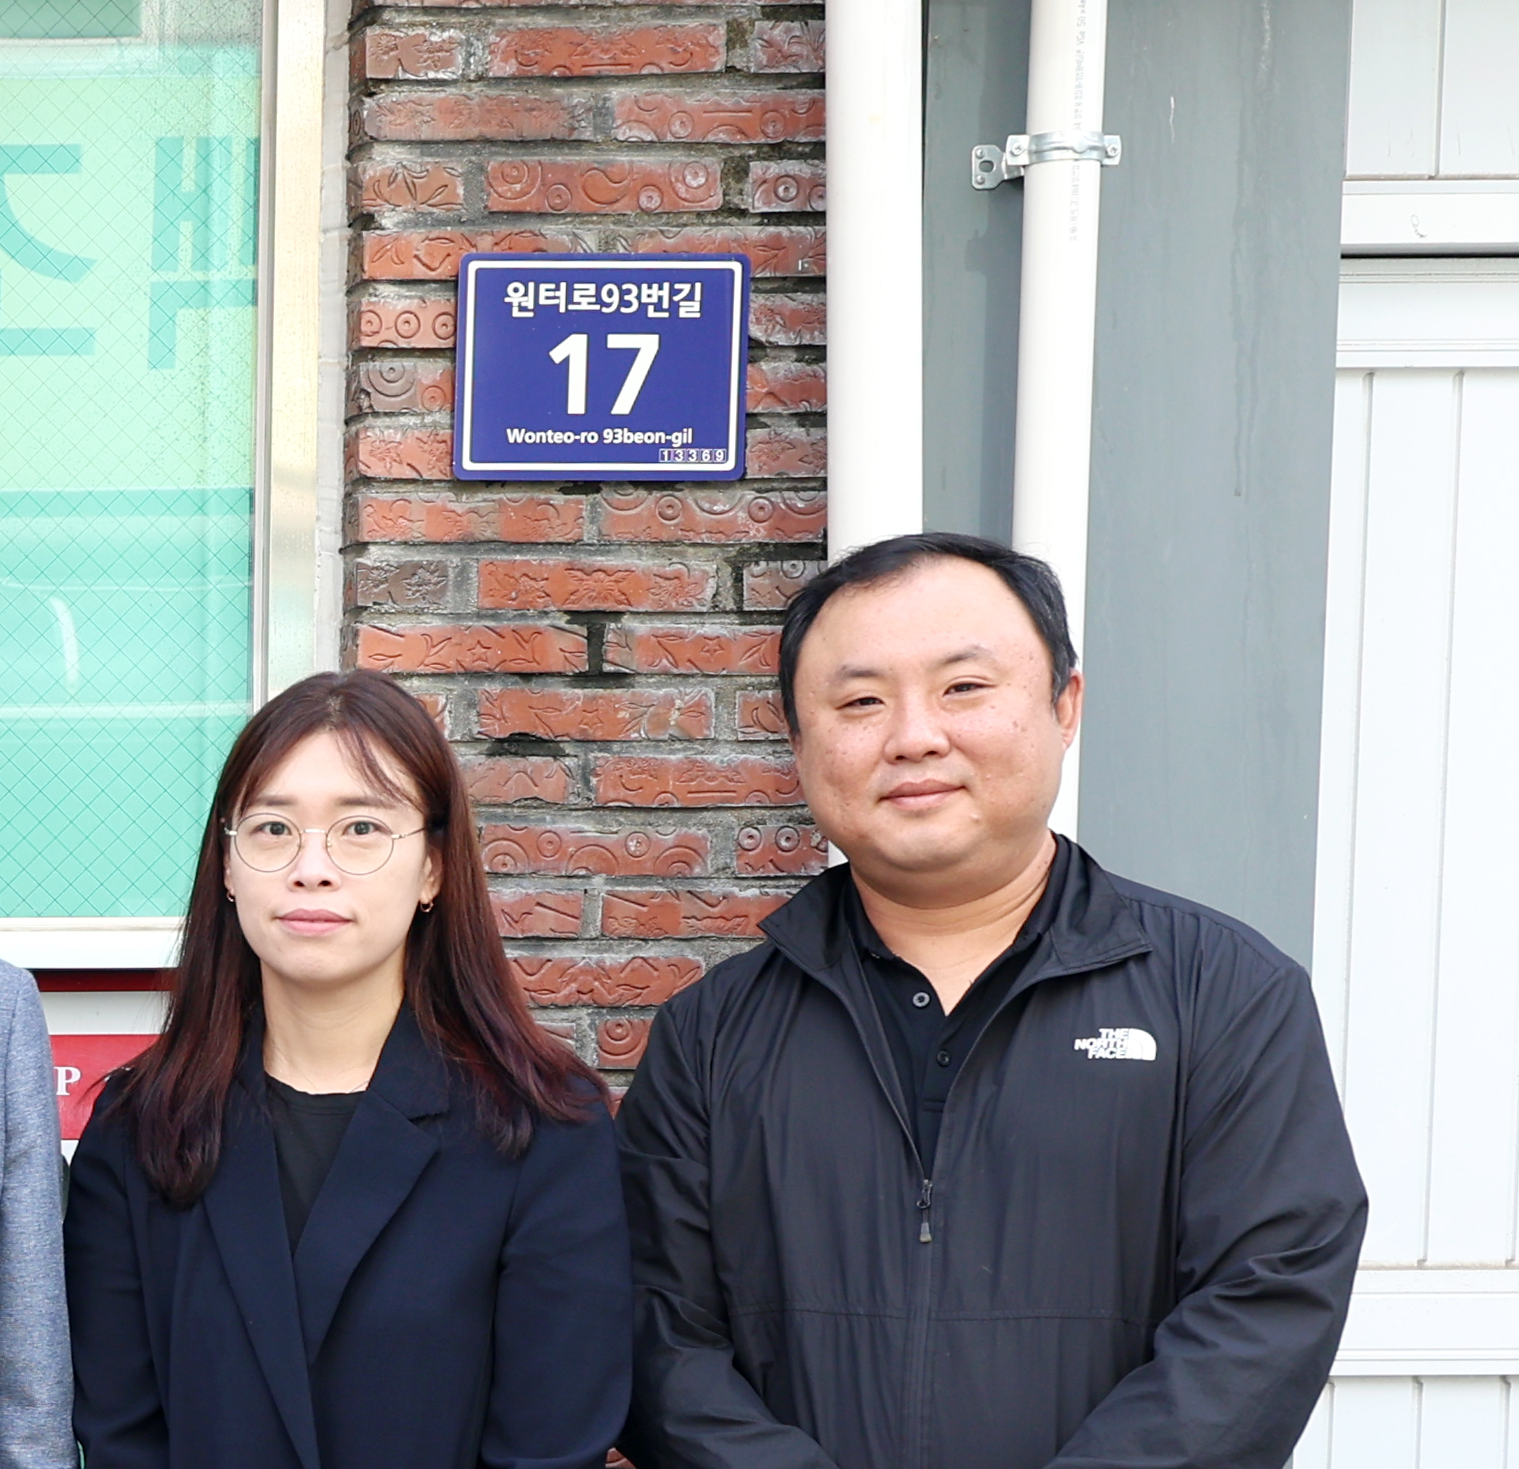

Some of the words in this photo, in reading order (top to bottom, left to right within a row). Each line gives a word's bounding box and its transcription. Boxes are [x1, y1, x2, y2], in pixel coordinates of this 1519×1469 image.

[504, 281, 702, 318] 원터로93번길
[548, 333, 660, 415] 17
[506, 428, 600, 445] Wonteo-ro
[602, 428, 694, 447] 93beon-gil
[660, 449, 727, 463] 13369
[1099, 1028, 1129, 1039] THE
[1074, 1038, 1128, 1050] NORTH
[1087, 1048, 1127, 1059] FACE
